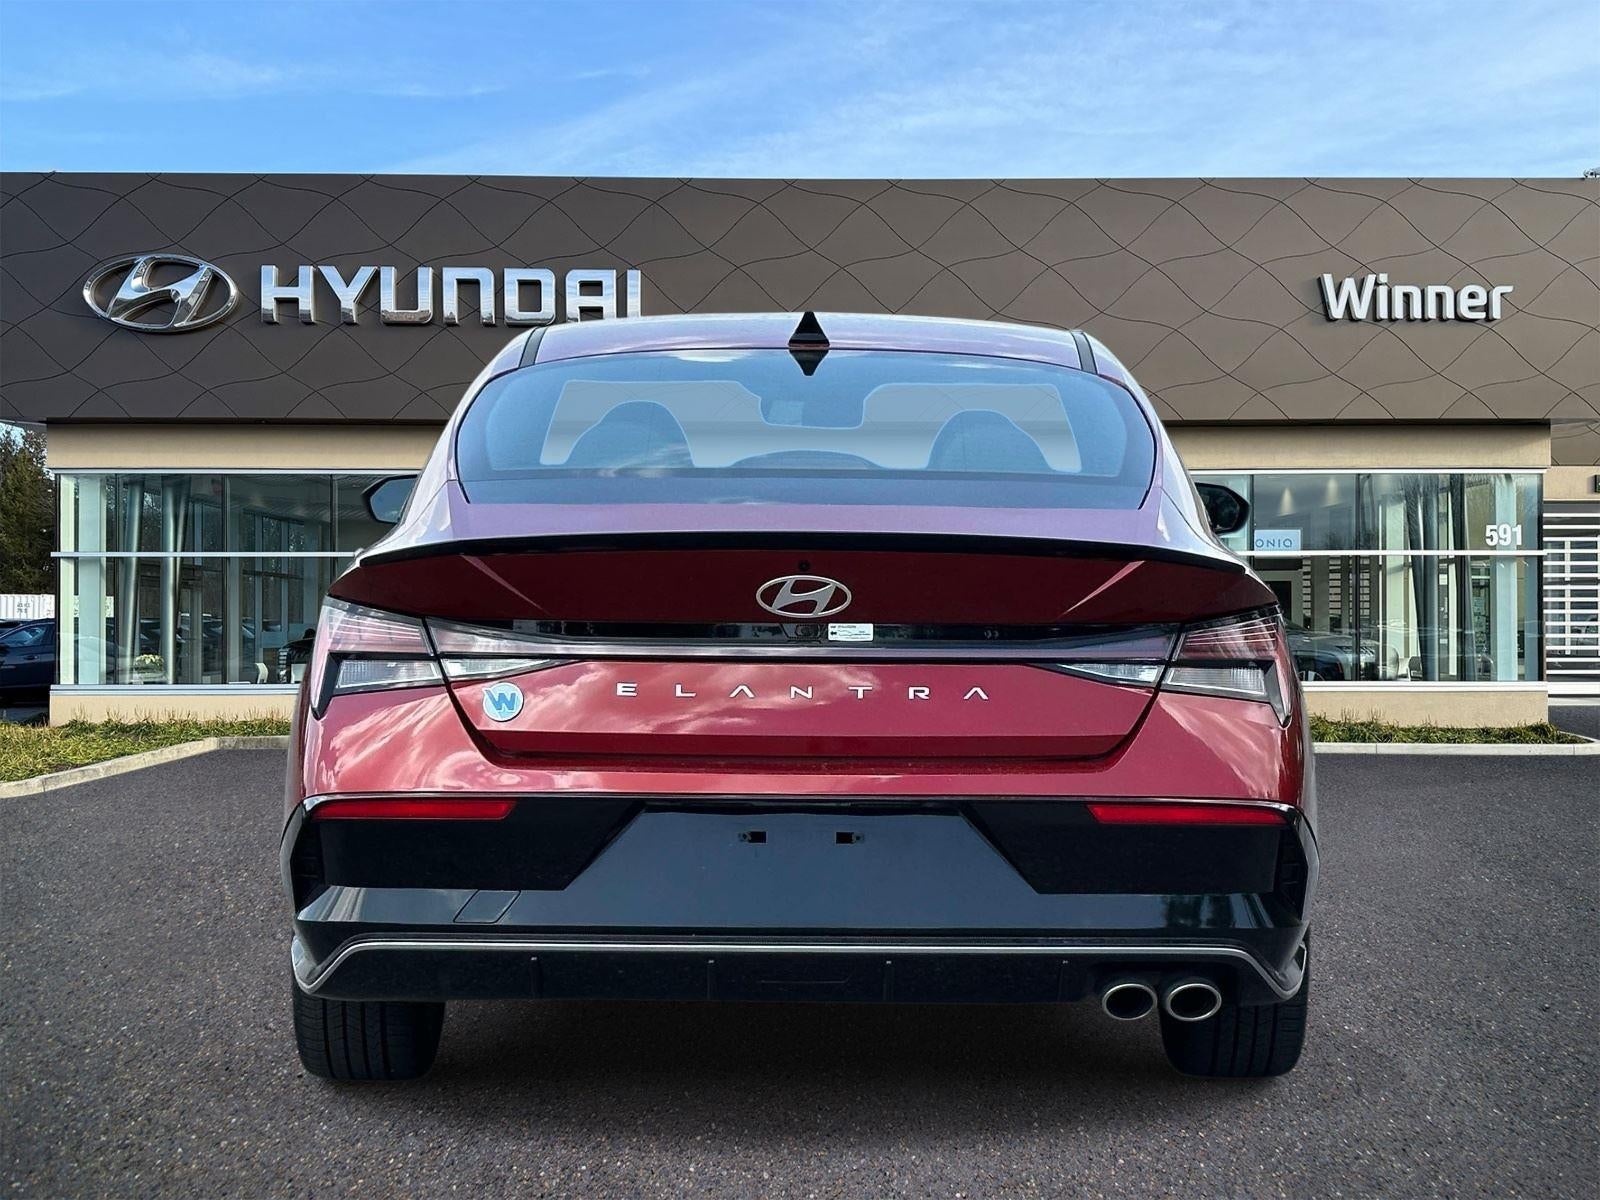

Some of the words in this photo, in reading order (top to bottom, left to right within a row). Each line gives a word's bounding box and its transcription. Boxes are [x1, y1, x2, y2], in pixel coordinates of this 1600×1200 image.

[260, 264, 642, 326] HYUNDAI
[1320, 273, 1514, 320] Winner
[1255, 538, 1293, 548] ONIQ
[1485, 524, 1522, 546] 591
[615, 681, 989, 701] ELANTRA
